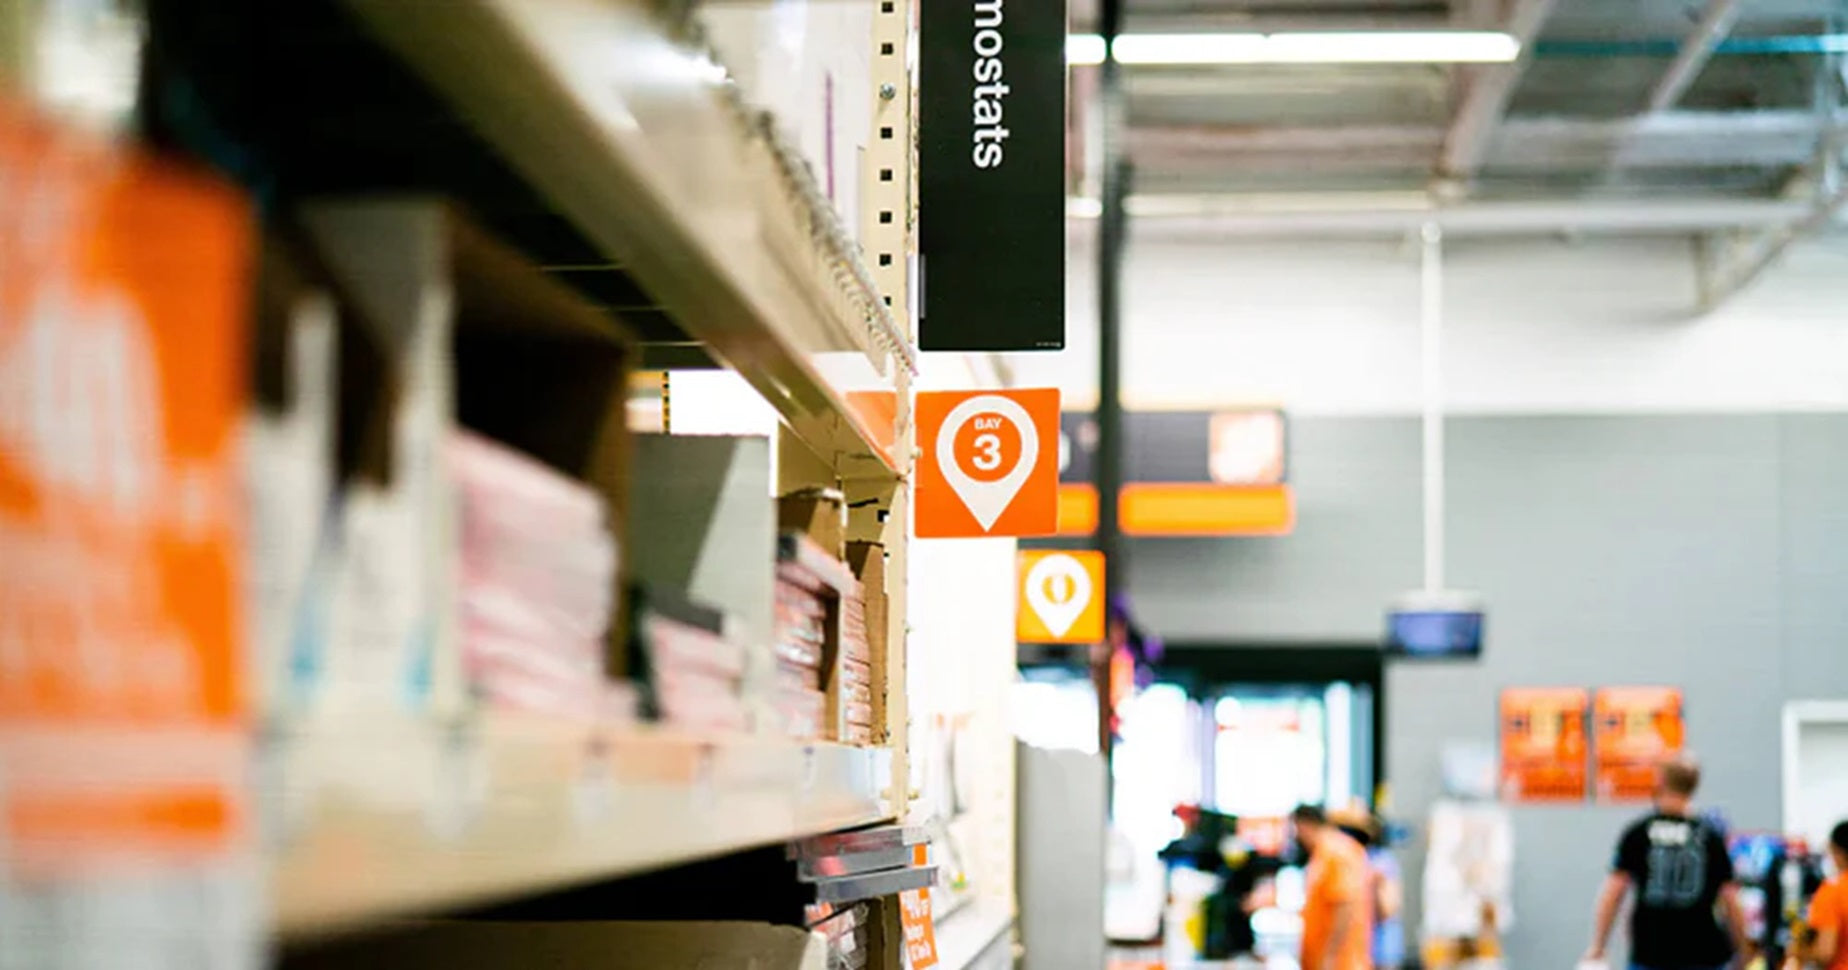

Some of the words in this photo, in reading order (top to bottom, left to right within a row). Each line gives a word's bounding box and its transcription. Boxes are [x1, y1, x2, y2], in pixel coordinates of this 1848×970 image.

[973, 0, 1010, 168] mostats
[974, 418, 1002, 430] BAY
[972, 433, 1002, 471] 3
